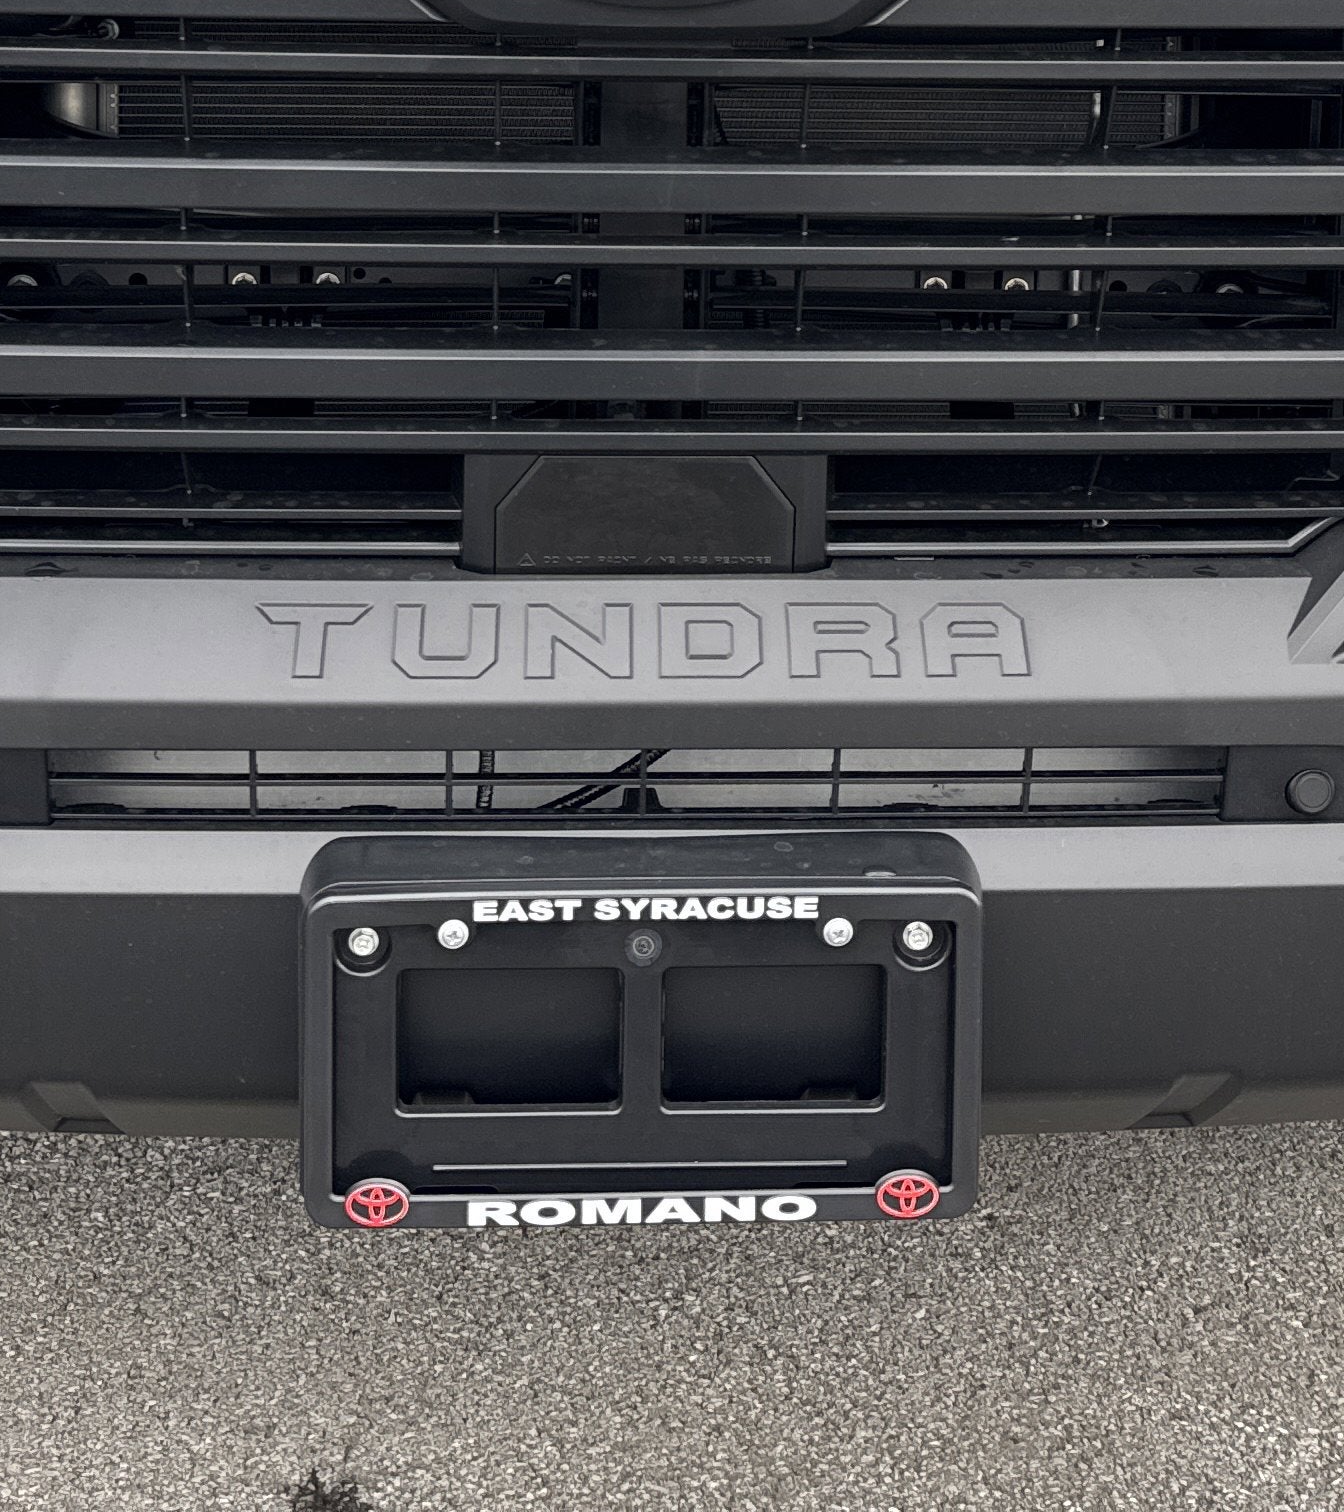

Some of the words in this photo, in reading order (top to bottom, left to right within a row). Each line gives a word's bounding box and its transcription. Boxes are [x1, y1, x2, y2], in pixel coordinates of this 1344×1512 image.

[255, 601, 1033, 680] TUNDRA
[472, 899, 583, 922] EAST
[593, 896, 820, 921] SYRACUSE
[466, 1194, 818, 1226] ROMANO
